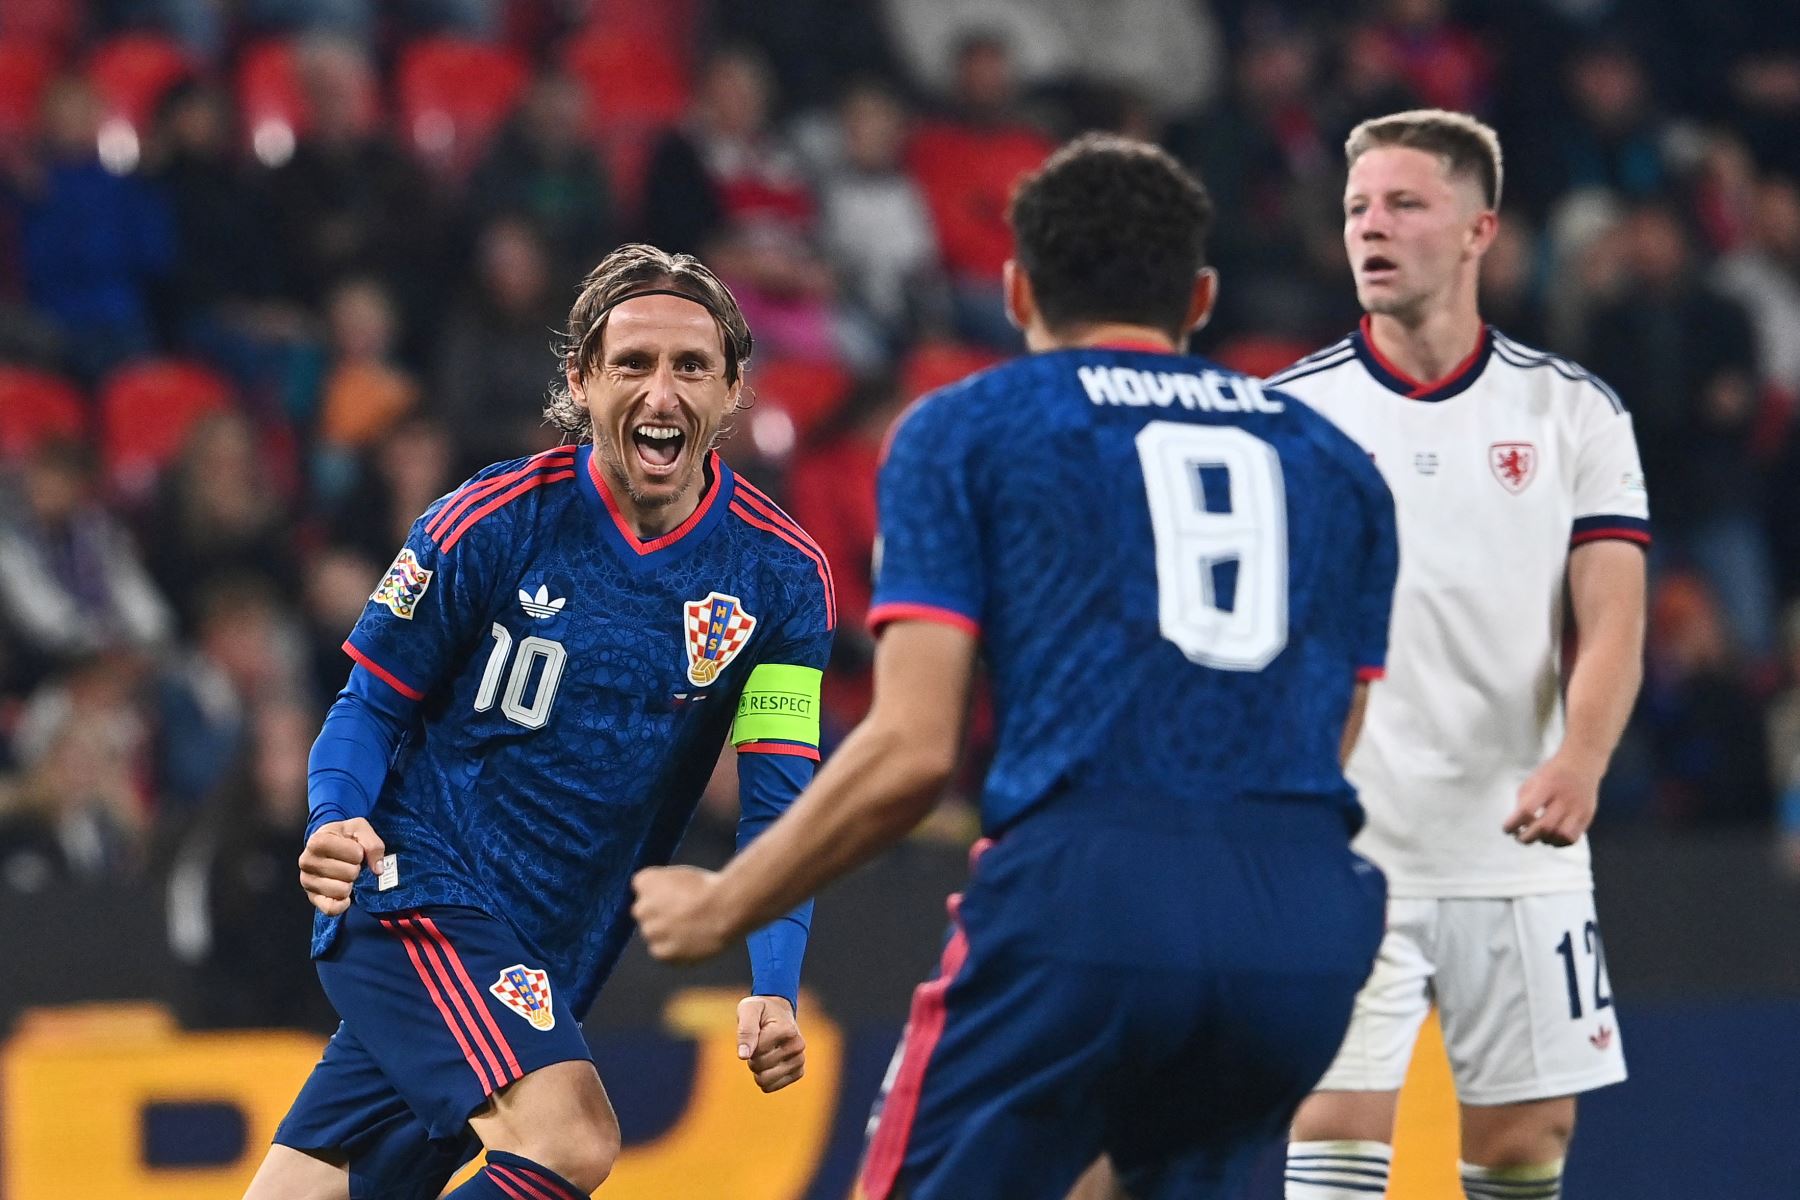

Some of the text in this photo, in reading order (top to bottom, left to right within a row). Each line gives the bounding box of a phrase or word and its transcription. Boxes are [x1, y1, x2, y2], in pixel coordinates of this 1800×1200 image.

[1135, 420, 1288, 672] 8
[474, 622, 568, 730] 10
[708, 605, 727, 651] HNS
[750, 696, 811, 714] RESPECT
[1556, 920, 1614, 1019] 12
